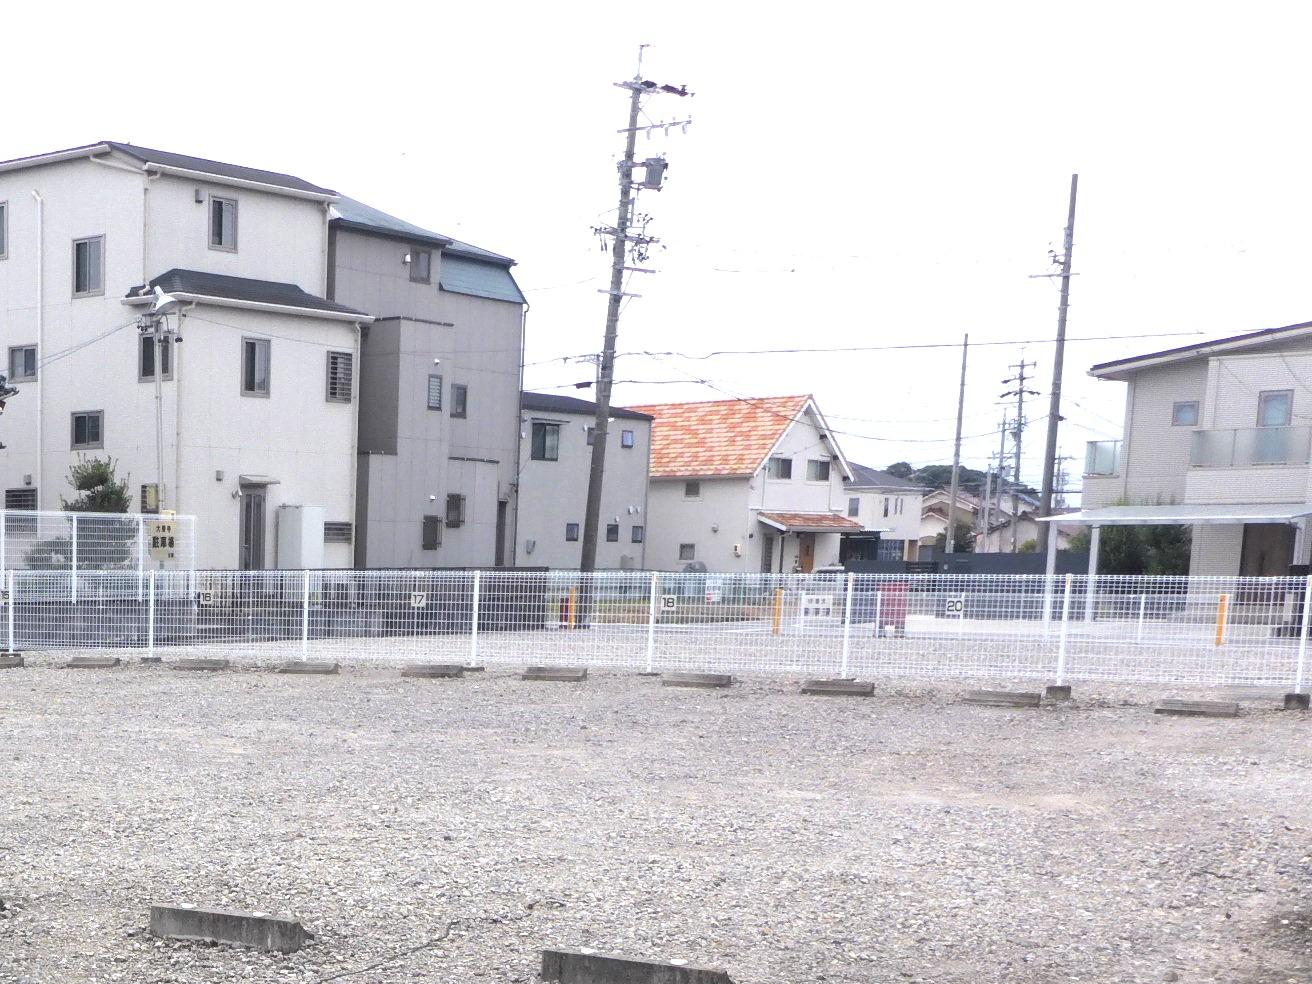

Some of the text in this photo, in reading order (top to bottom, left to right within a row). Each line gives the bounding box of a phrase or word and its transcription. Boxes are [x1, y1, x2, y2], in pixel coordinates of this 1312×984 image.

[201, 592, 212, 602] 16
[412, 594, 425, 605] 17
[662, 597, 675, 608] 18
[947, 600, 963, 612] 20
